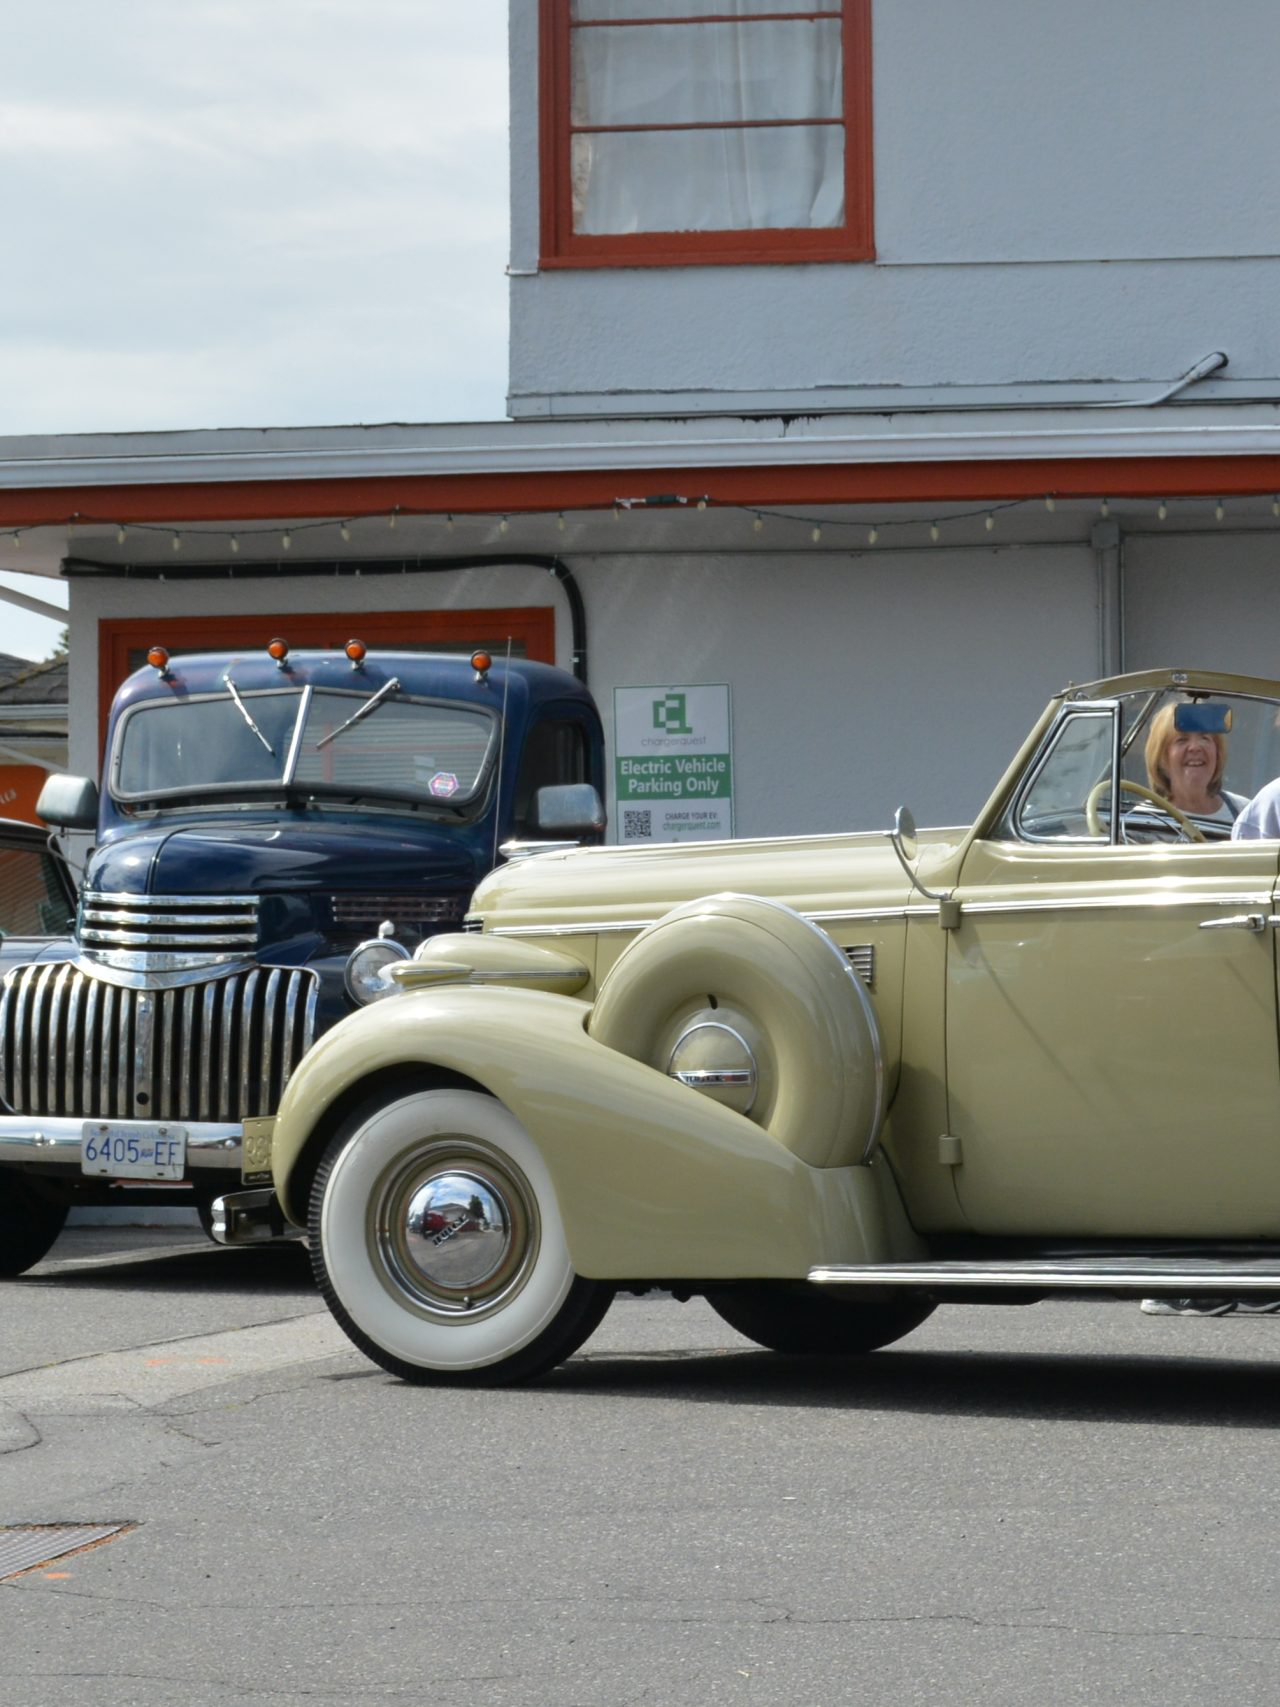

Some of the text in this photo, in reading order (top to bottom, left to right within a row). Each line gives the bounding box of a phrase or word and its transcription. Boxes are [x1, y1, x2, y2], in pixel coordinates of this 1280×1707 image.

[620, 757, 726, 775] Electric Vehicle
[628, 776, 719, 796] Parking Only
[665, 812, 689, 820] CHARGE
[691, 812, 707, 820] YOUR
[86, 1137, 139, 1163] 6405
[154, 1141, 181, 1166] EF
